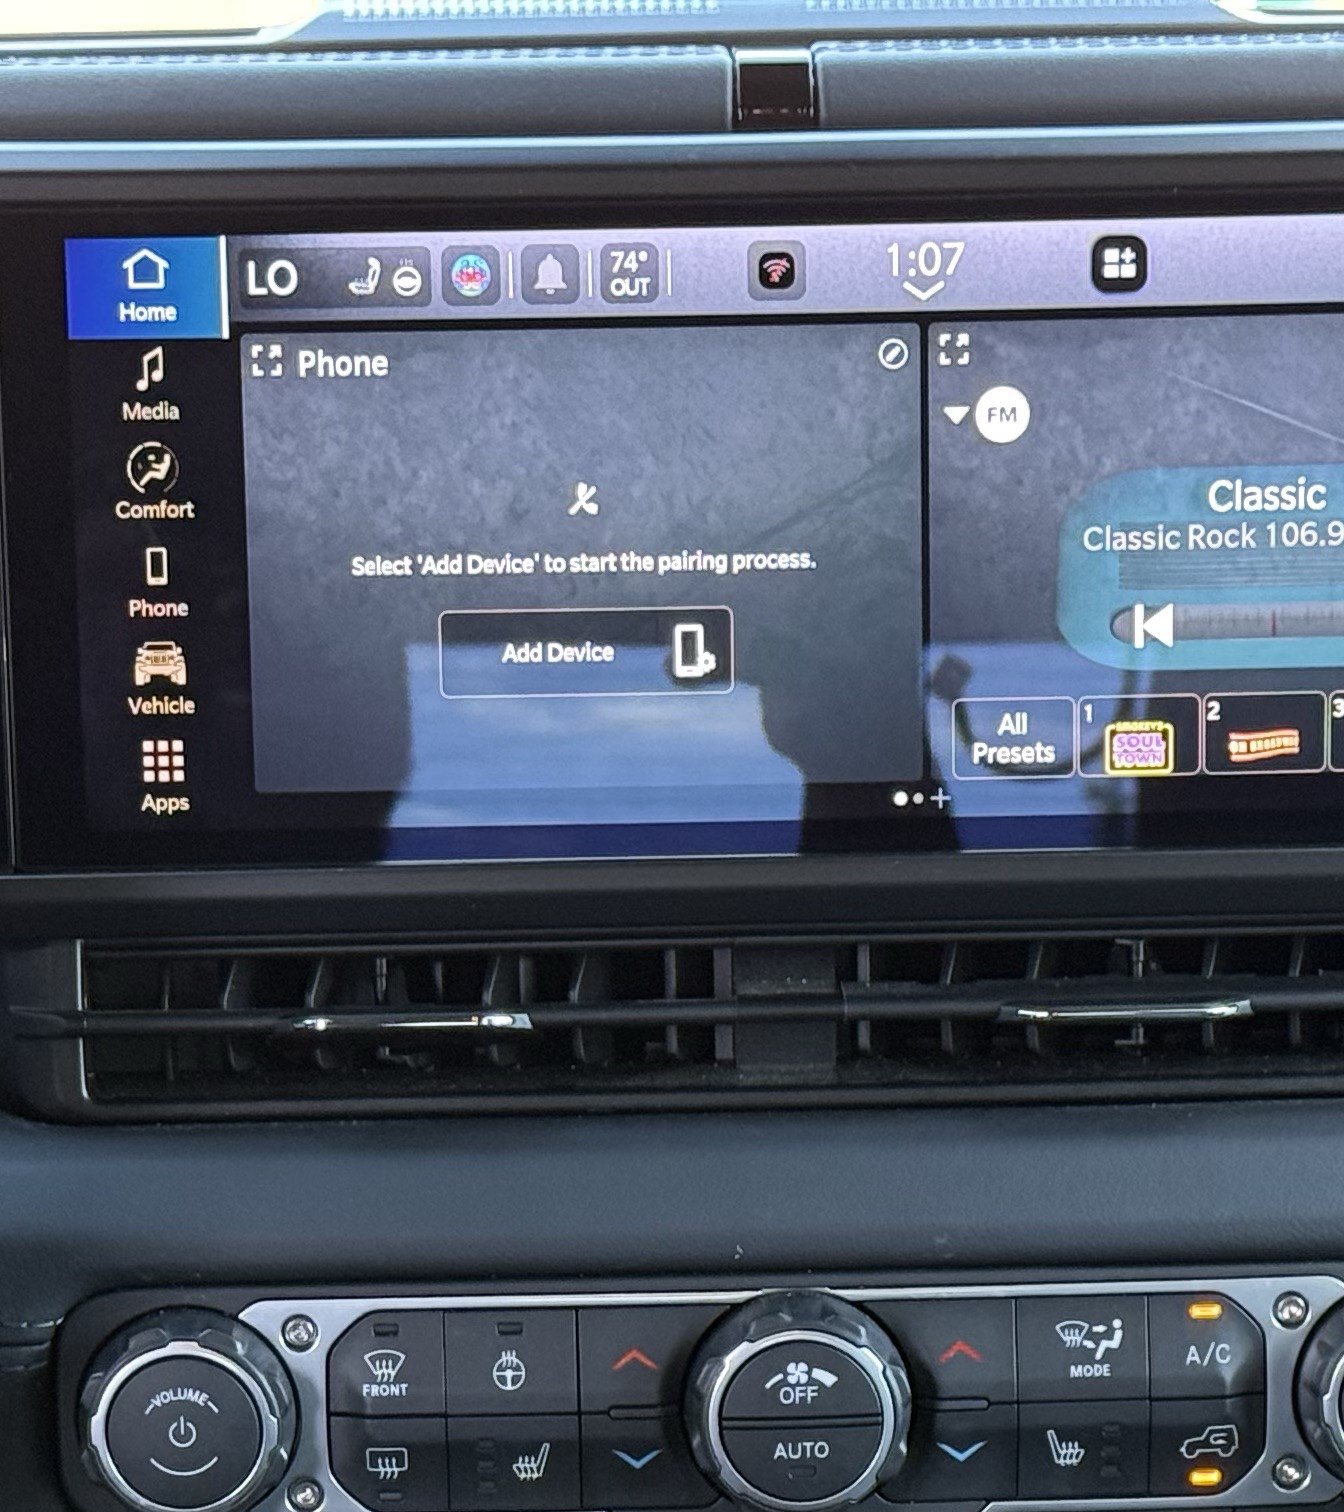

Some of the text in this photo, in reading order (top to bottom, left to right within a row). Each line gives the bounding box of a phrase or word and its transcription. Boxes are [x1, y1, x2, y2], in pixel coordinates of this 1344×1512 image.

[886, 242, 965, 277] 1:07
[246, 258, 298, 296] LO
[610, 277, 652, 297] OUT
[119, 302, 178, 322] Home
[297, 349, 389, 378] Phone
[122, 401, 180, 421] Media
[987, 406, 1018, 423] FM
[1207, 476, 1327, 513] Classic
[115, 500, 196, 520] Comfort
[1082, 525, 1181, 552] Classic
[1187, 521, 1256, 550] Rock
[351, 549, 818, 576] Select 'Add Device' to start the pairing process.
[129, 599, 189, 618] Phone
[501, 640, 615, 664] Add Device
[128, 696, 196, 716] Vehicle
[1084, 703, 1094, 724] 1
[1206, 700, 1221, 721] 2
[997, 711, 1028, 737] All
[1116, 734, 1165, 748] SOUL
[973, 742, 1056, 765] Presets
[1115, 751, 1164, 767] TOWN
[141, 793, 191, 815] Apps
[1185, 1343, 1232, 1367] A/C
[1069, 1363, 1112, 1378] MODE
[150, 1387, 210, 1407] VOLUME
[362, 1383, 408, 1397] FRONT
[779, 1385, 820, 1405] OFF
[773, 1441, 829, 1460] AUTO
